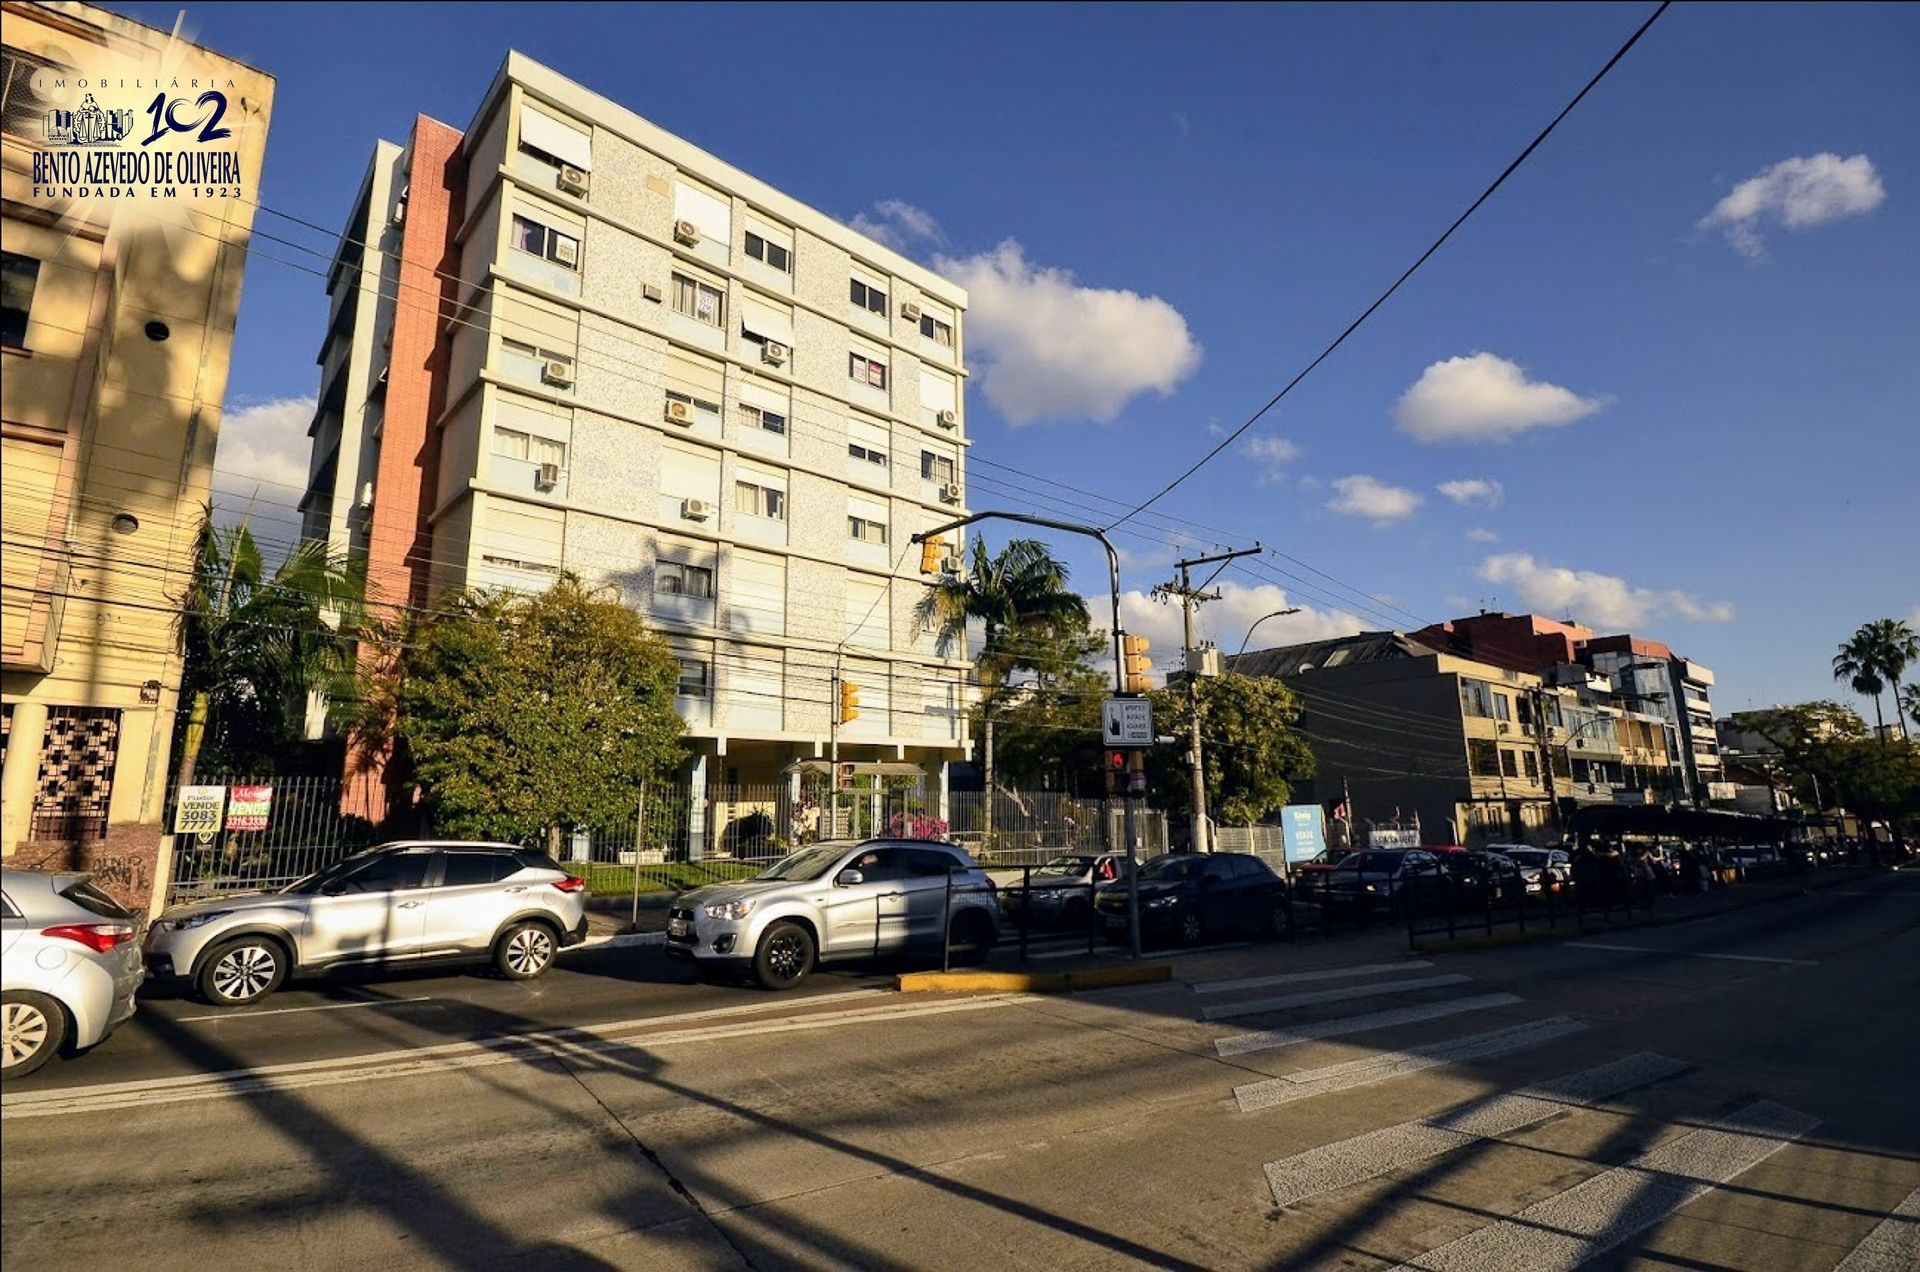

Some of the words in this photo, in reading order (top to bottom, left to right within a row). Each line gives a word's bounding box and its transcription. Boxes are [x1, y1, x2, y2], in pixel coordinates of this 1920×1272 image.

[182, 801, 220, 810] VENDE
[230, 802, 270, 815] VENDE
[181, 810, 217, 820] 3083
[180, 820, 217, 830] 7777
